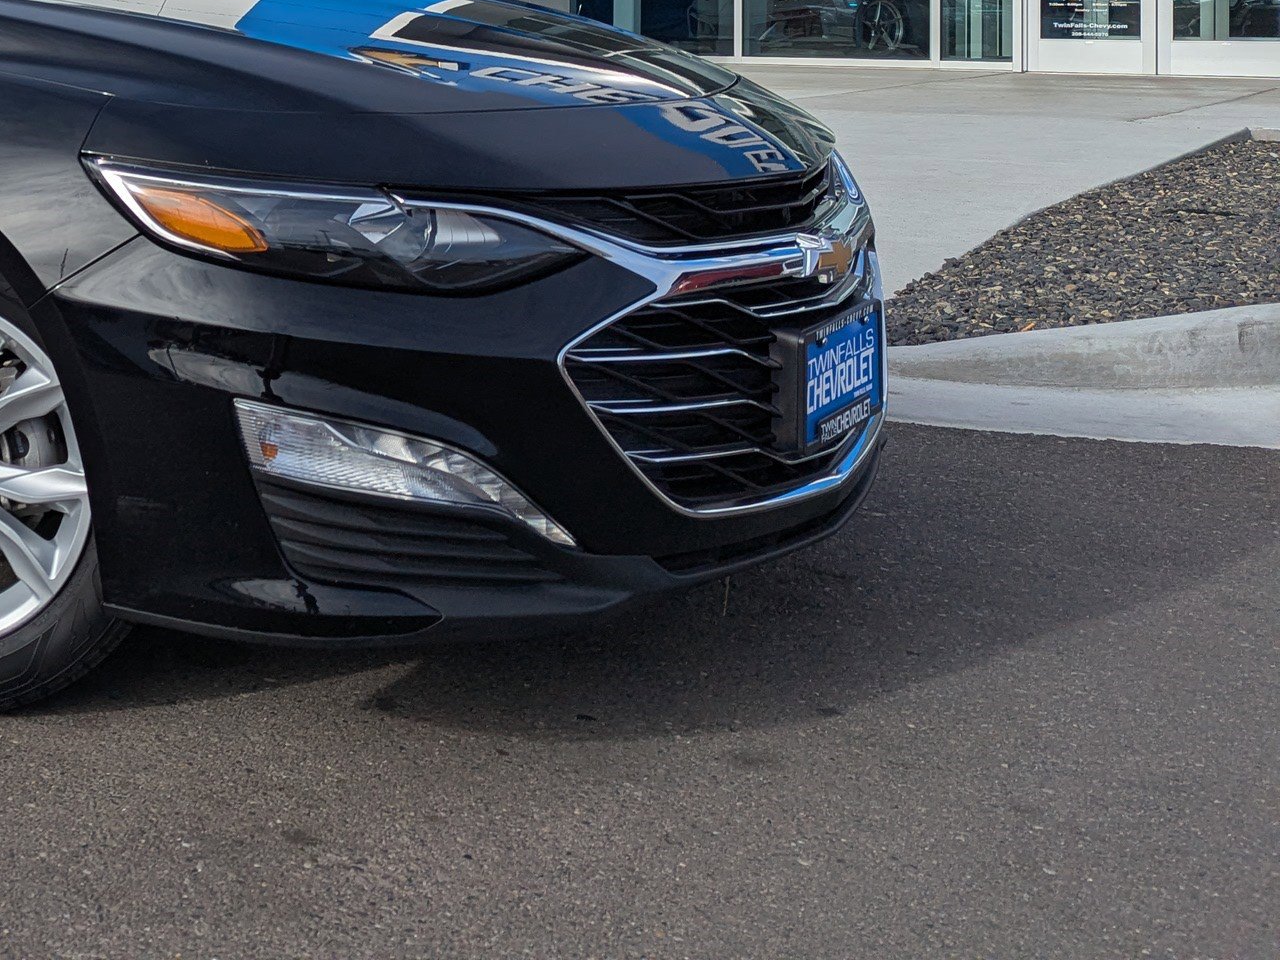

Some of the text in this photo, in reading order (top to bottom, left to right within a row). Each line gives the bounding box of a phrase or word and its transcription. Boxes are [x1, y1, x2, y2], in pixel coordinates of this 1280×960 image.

[807, 328, 874, 380] TWINFALLS
[806, 347, 875, 414] CHEVROLET
[836, 398, 871, 434] CHEVROLET
